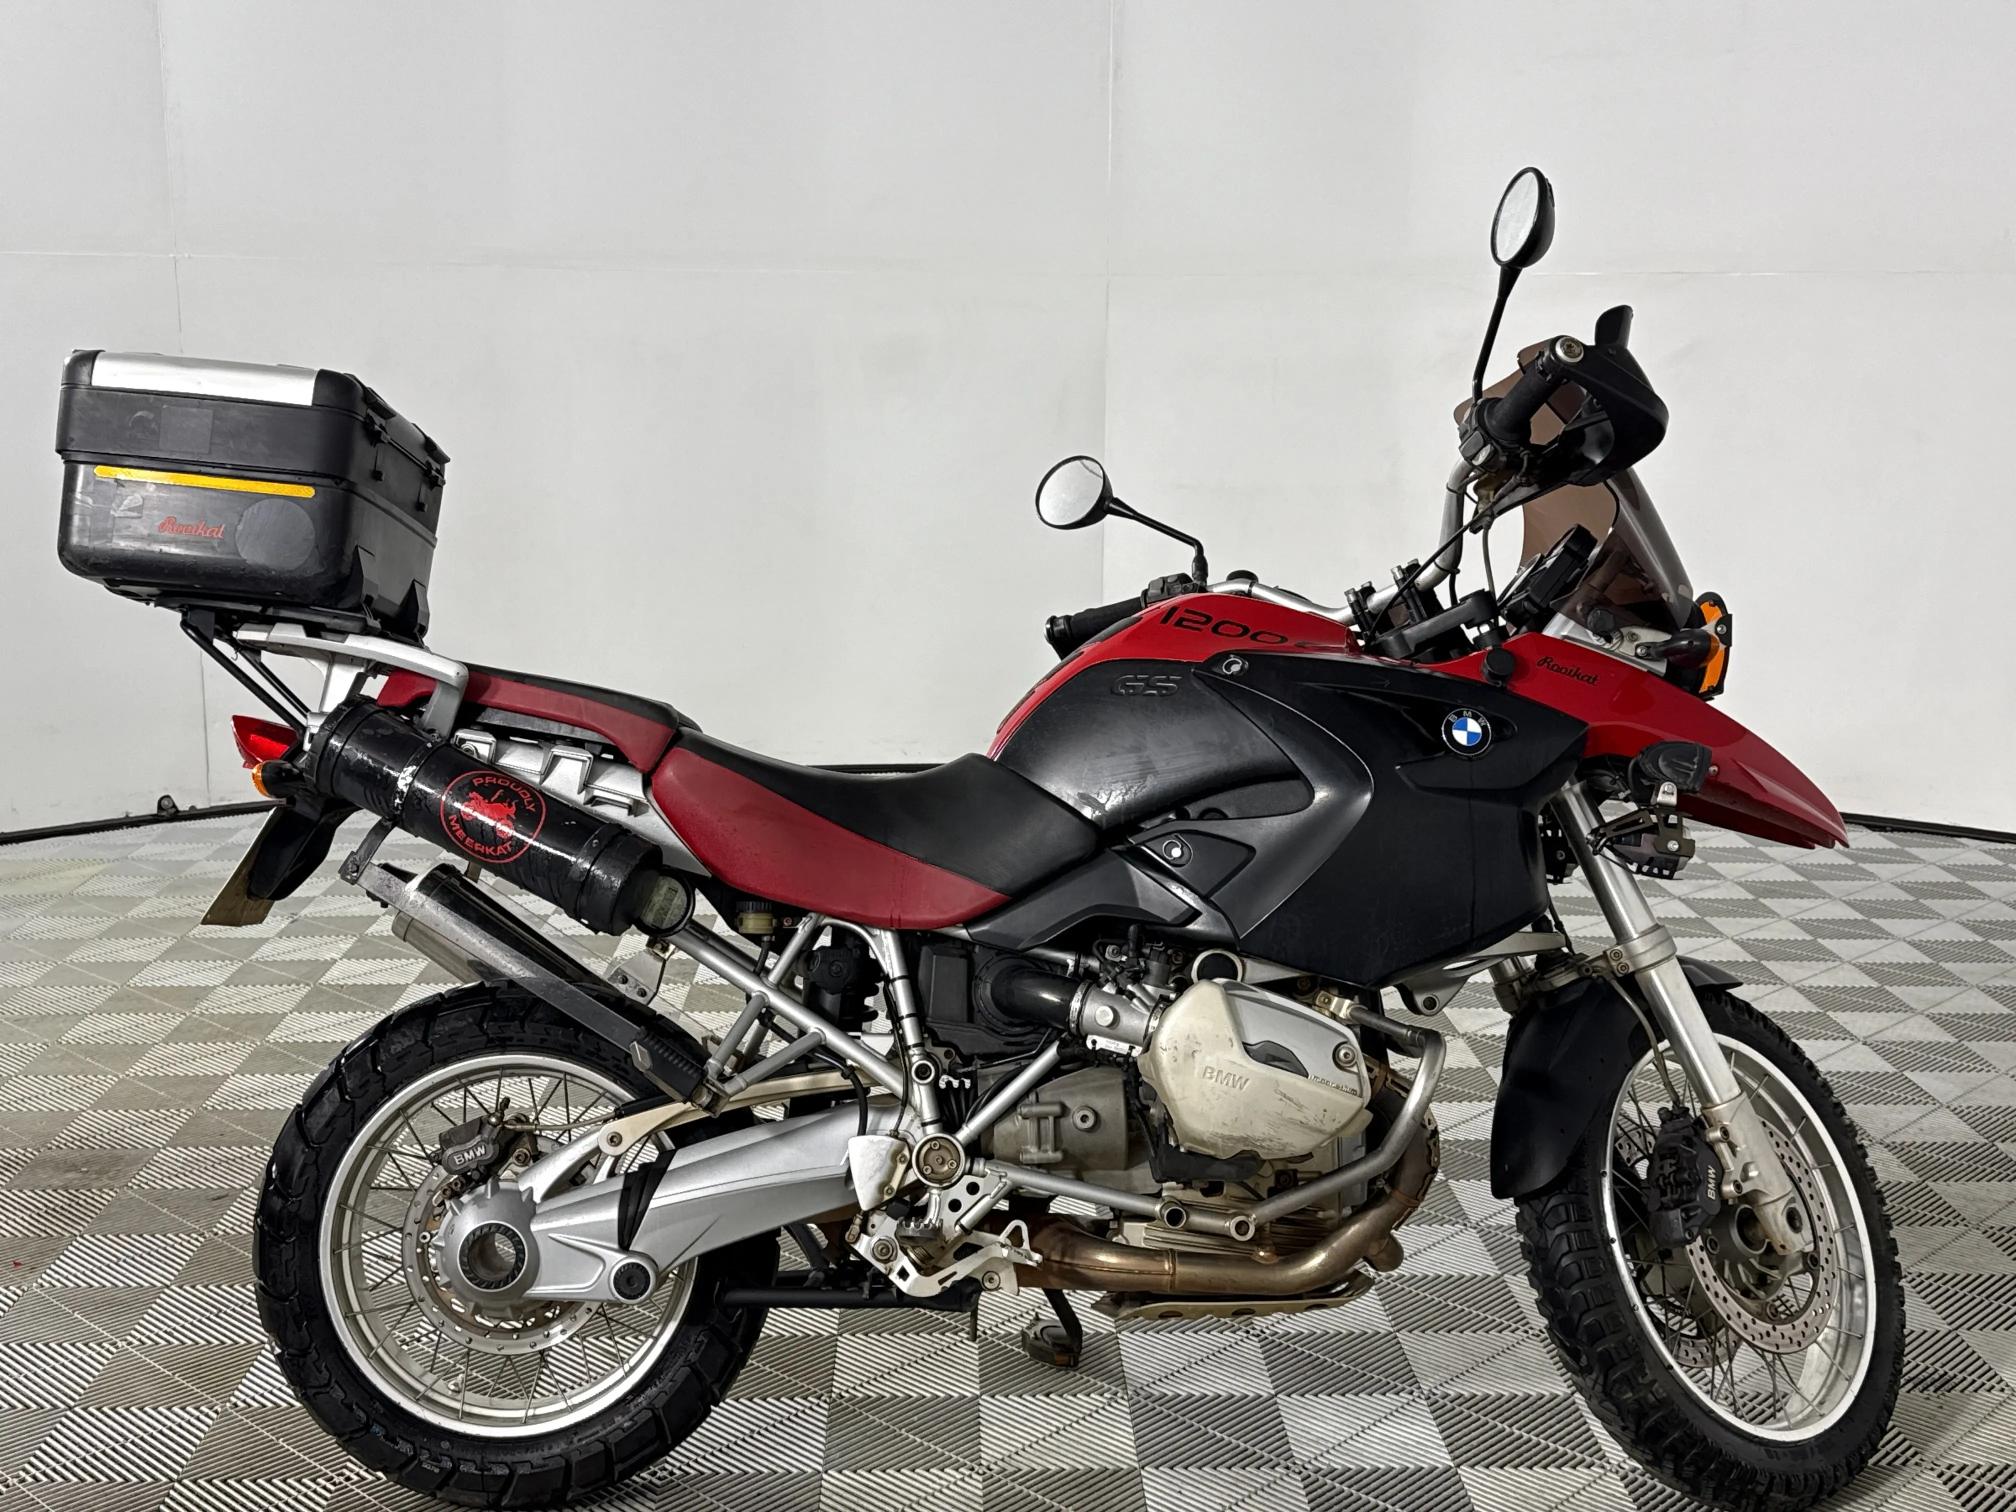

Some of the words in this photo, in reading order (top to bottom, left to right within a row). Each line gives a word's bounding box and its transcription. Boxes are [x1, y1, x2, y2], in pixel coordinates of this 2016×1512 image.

[1111, 674, 1183, 697] GS
[1448, 710, 1487, 726] BMW
[472, 776, 536, 812] PROUDLY
[449, 815, 512, 856] MEERKAT
[1202, 1065, 1250, 1092] BMW
[453, 1145, 486, 1165] BMW
[1707, 1165, 1717, 1200] BMW
